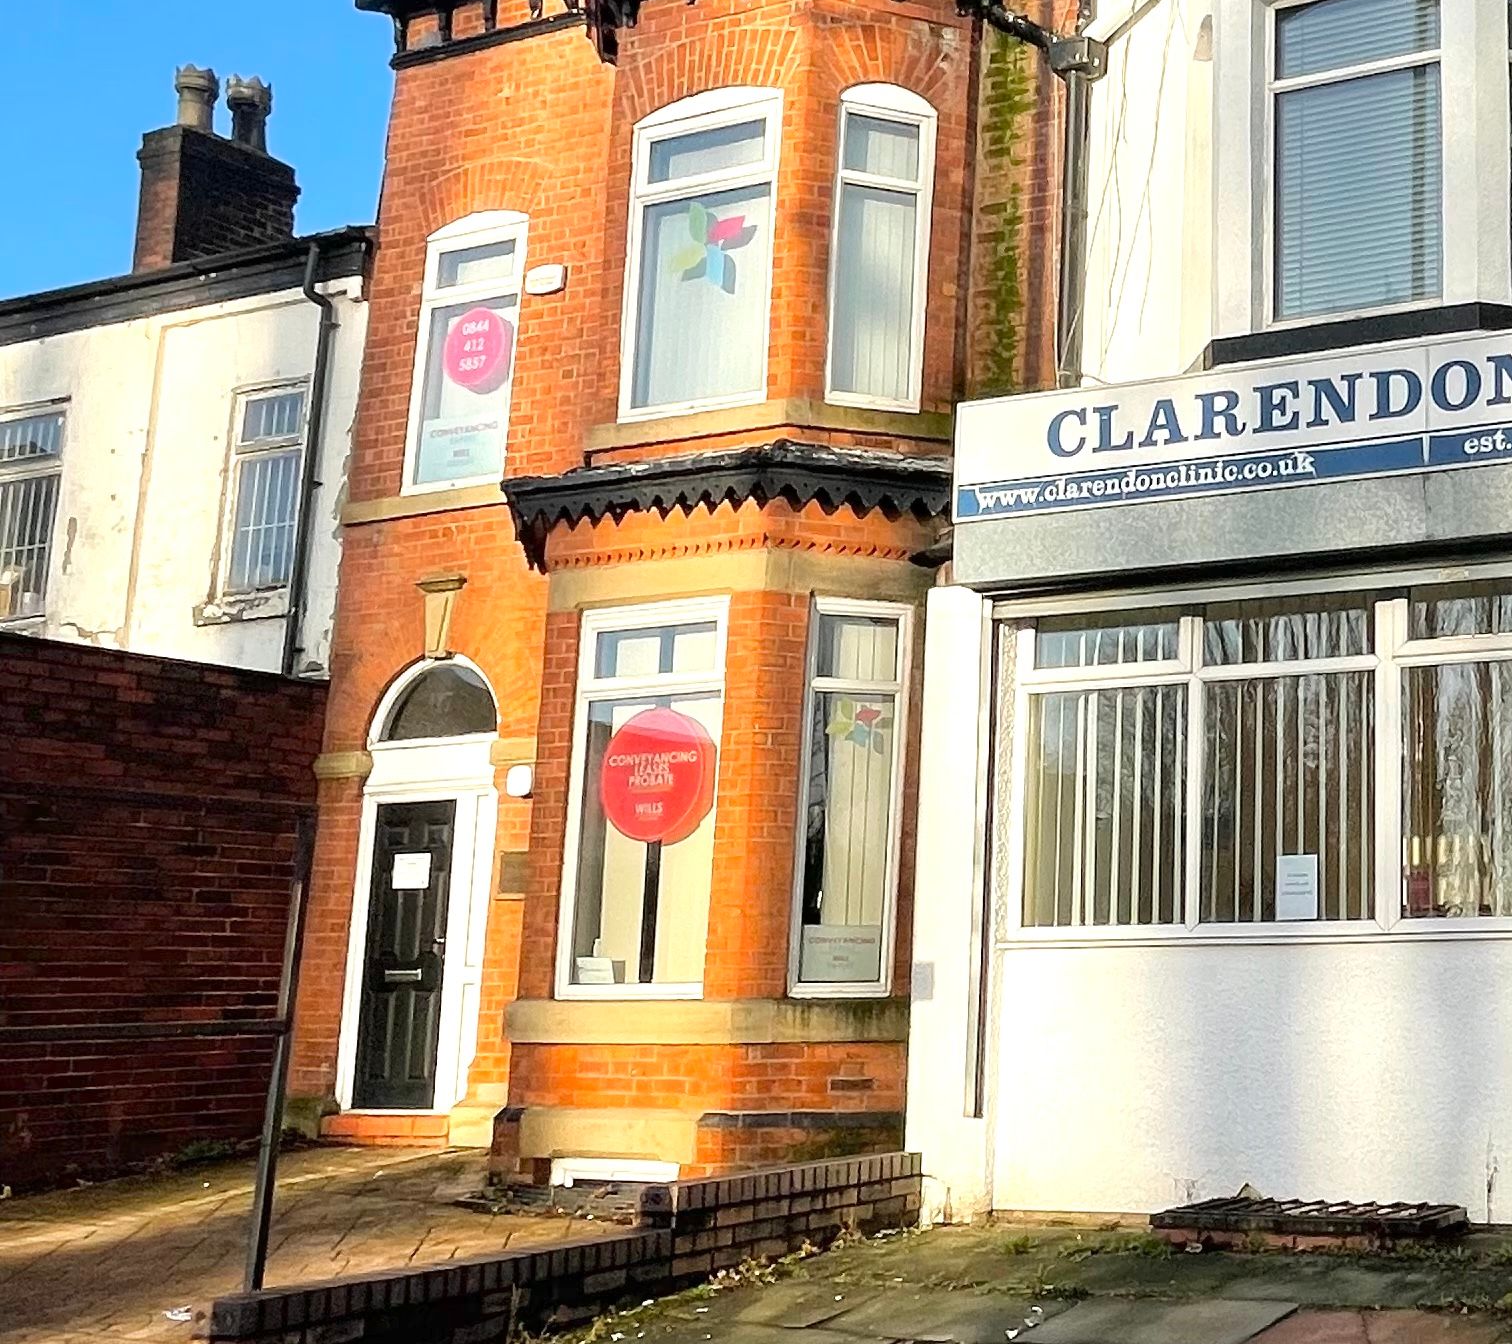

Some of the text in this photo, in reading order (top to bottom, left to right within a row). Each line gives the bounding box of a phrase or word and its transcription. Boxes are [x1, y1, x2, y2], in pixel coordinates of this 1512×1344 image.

[464, 337, 485, 353] 412
[1463, 429, 1512, 455] est.
[979, 452, 1314, 511] www.clarendonclinic.co.uk
[608, 750, 698, 767] CONVEYANCING
[628, 773, 674, 787] PROBATE
[635, 802, 663, 815] WILLS
